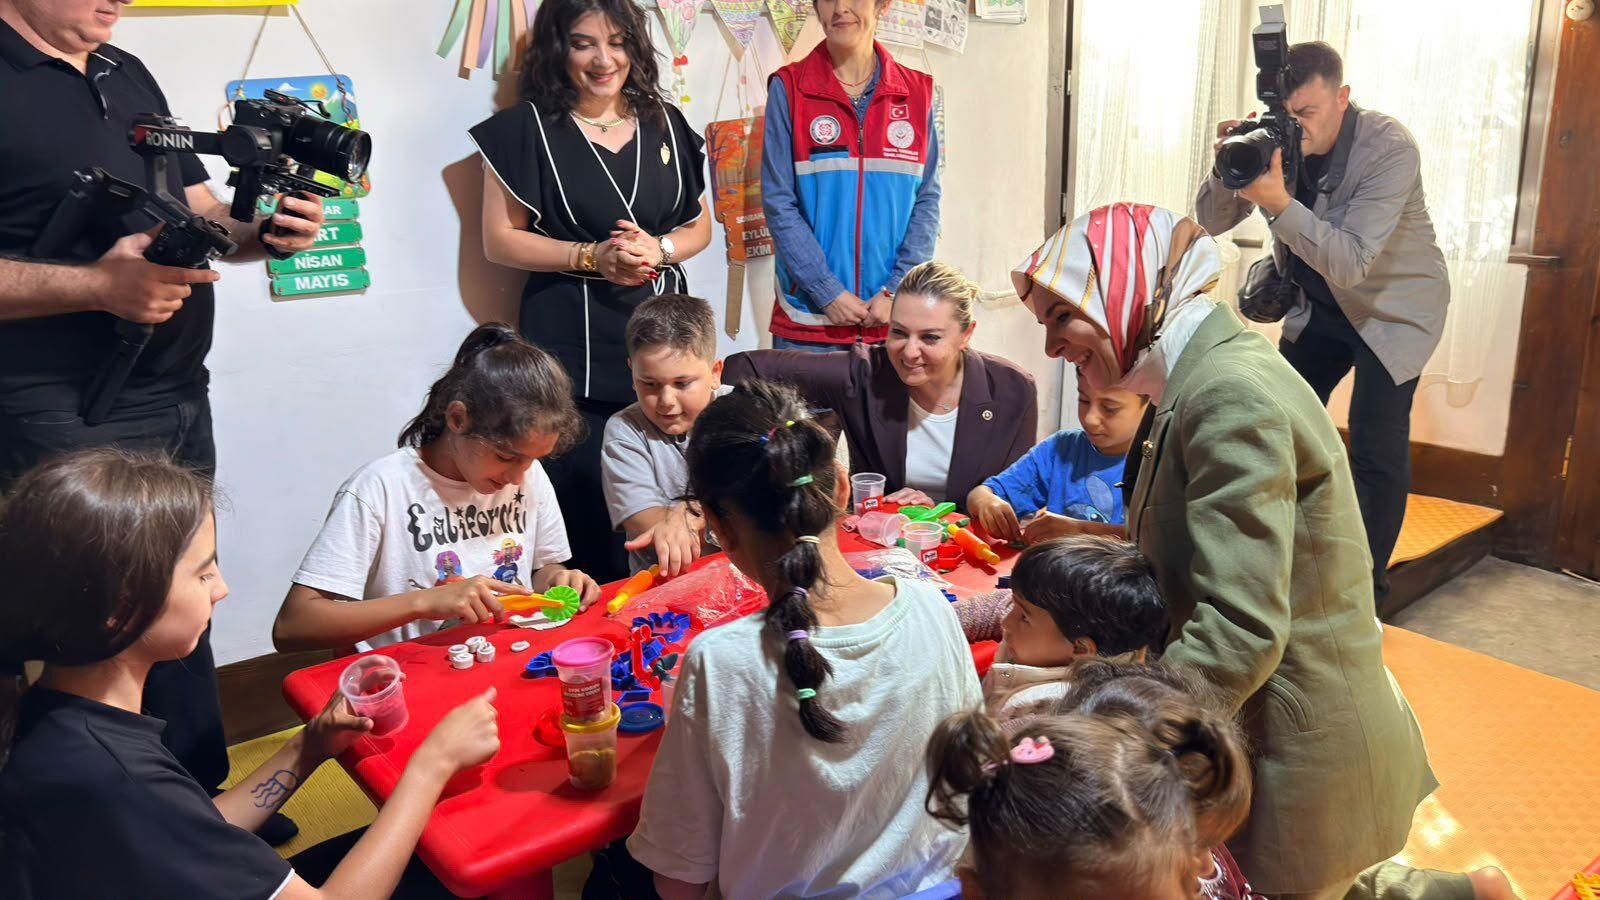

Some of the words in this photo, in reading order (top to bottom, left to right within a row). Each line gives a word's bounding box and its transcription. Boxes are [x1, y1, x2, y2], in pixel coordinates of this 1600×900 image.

[145, 131, 194, 149] RONIN
[323, 205, 342, 215] AR
[314, 226, 339, 241] RT
[294, 253, 343, 270] NİSAN
[294, 273, 350, 291] MAYIS
